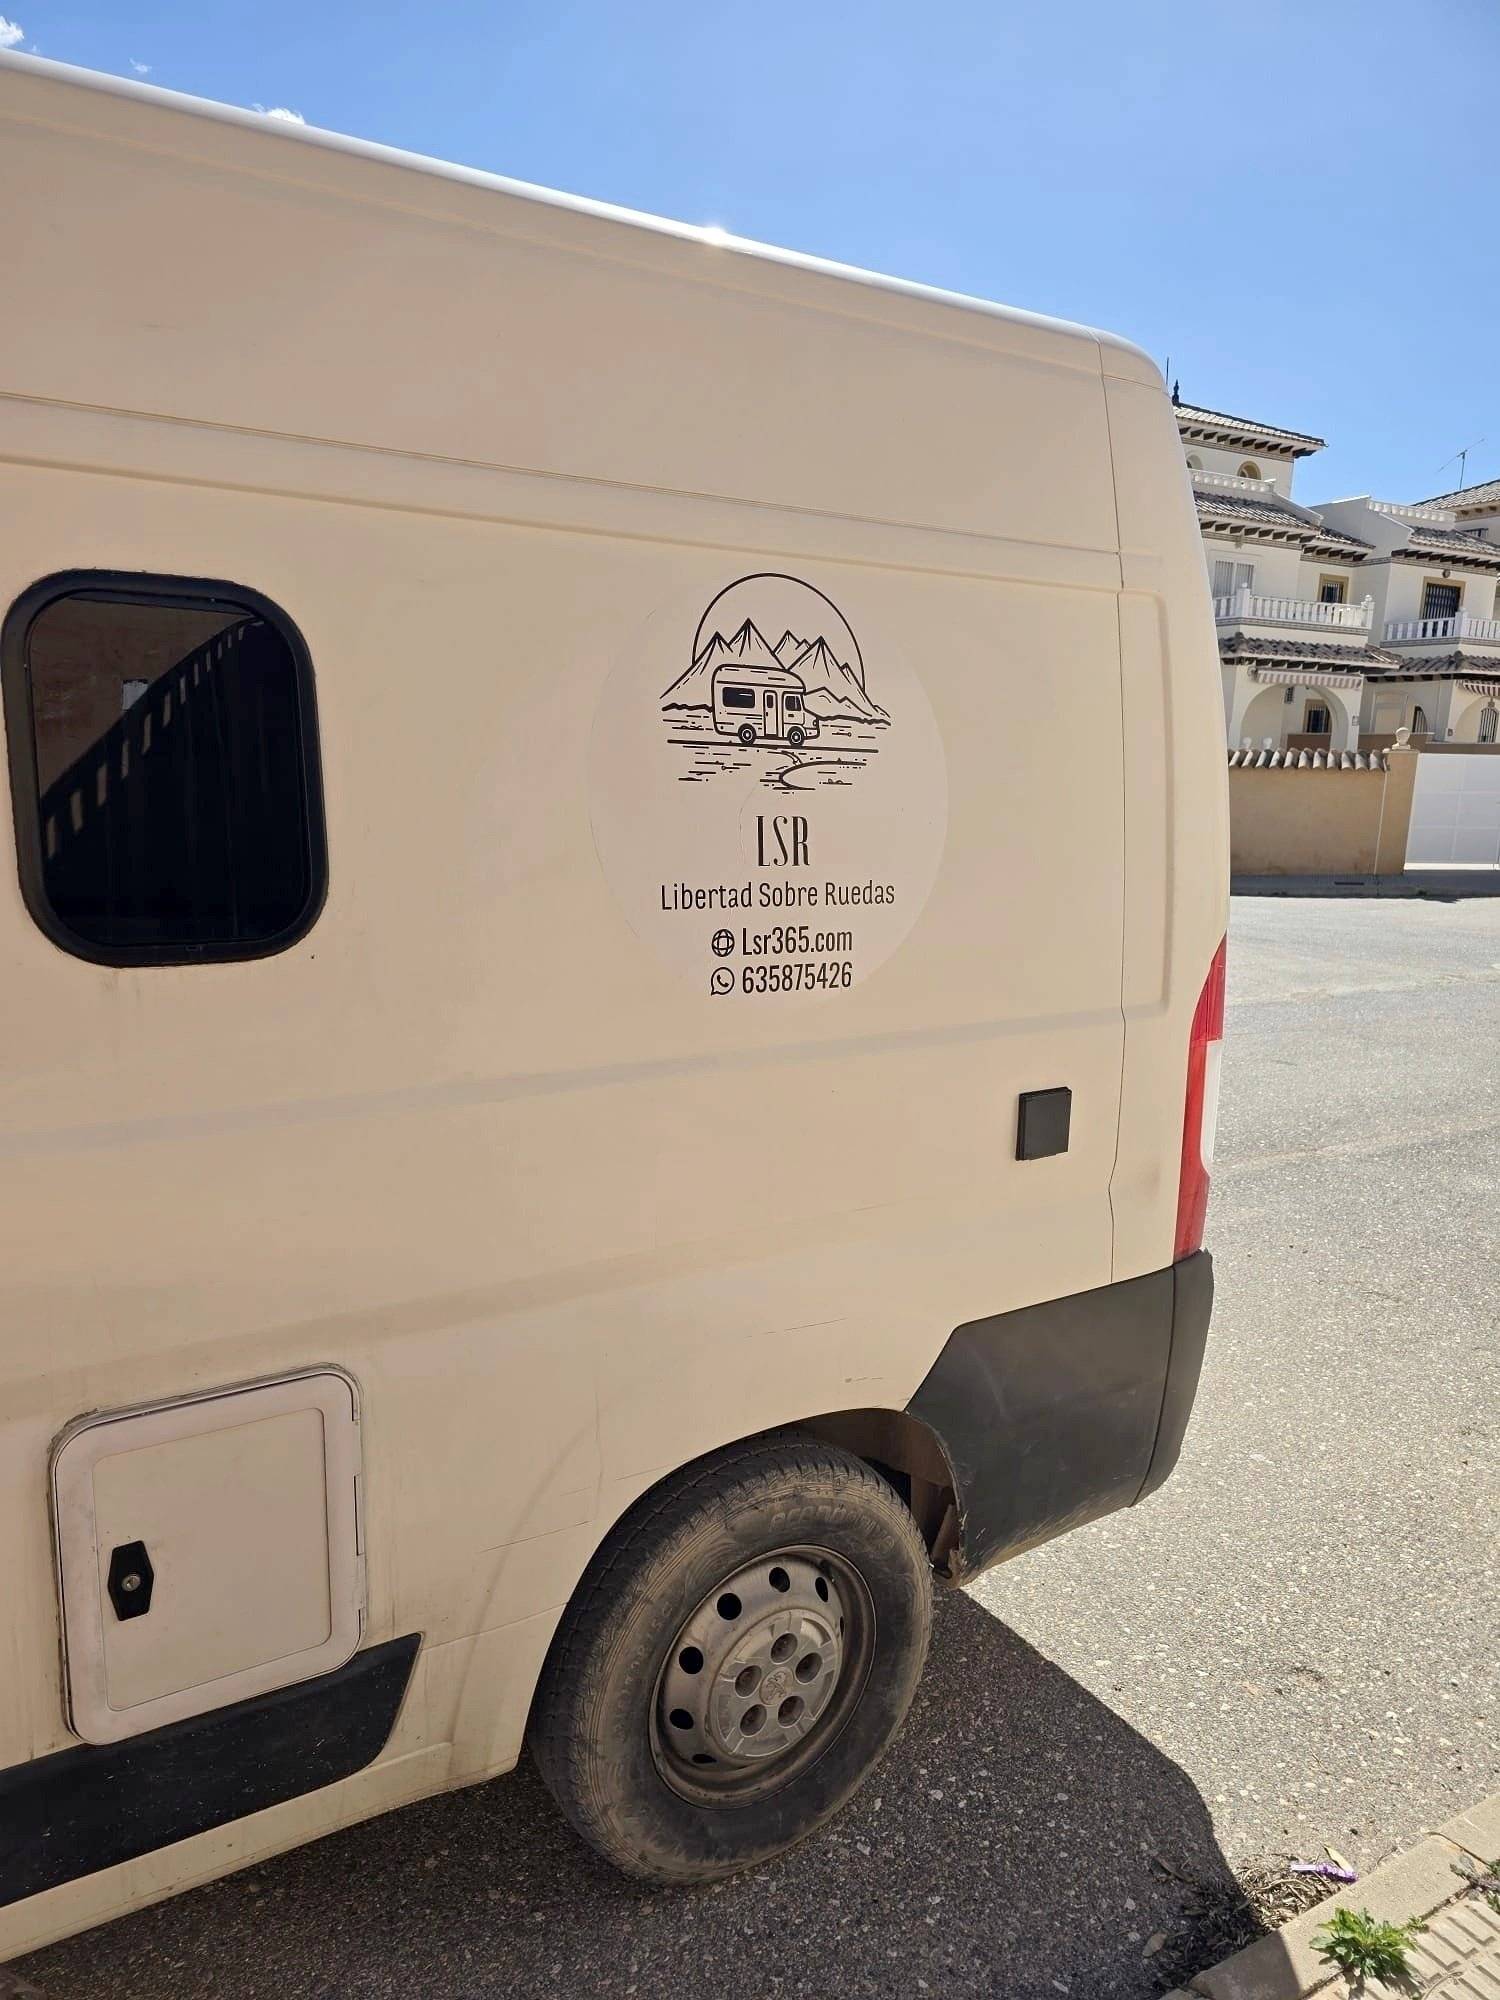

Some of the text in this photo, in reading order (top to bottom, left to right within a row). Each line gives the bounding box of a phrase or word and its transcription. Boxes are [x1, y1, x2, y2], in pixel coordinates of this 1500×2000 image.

[755, 815, 811, 867] LSR
[661, 879, 895, 911] Libertad Sobre Ruedas
[742, 925, 853, 956] Lsr365.com
[742, 961, 853, 994] 635875426
